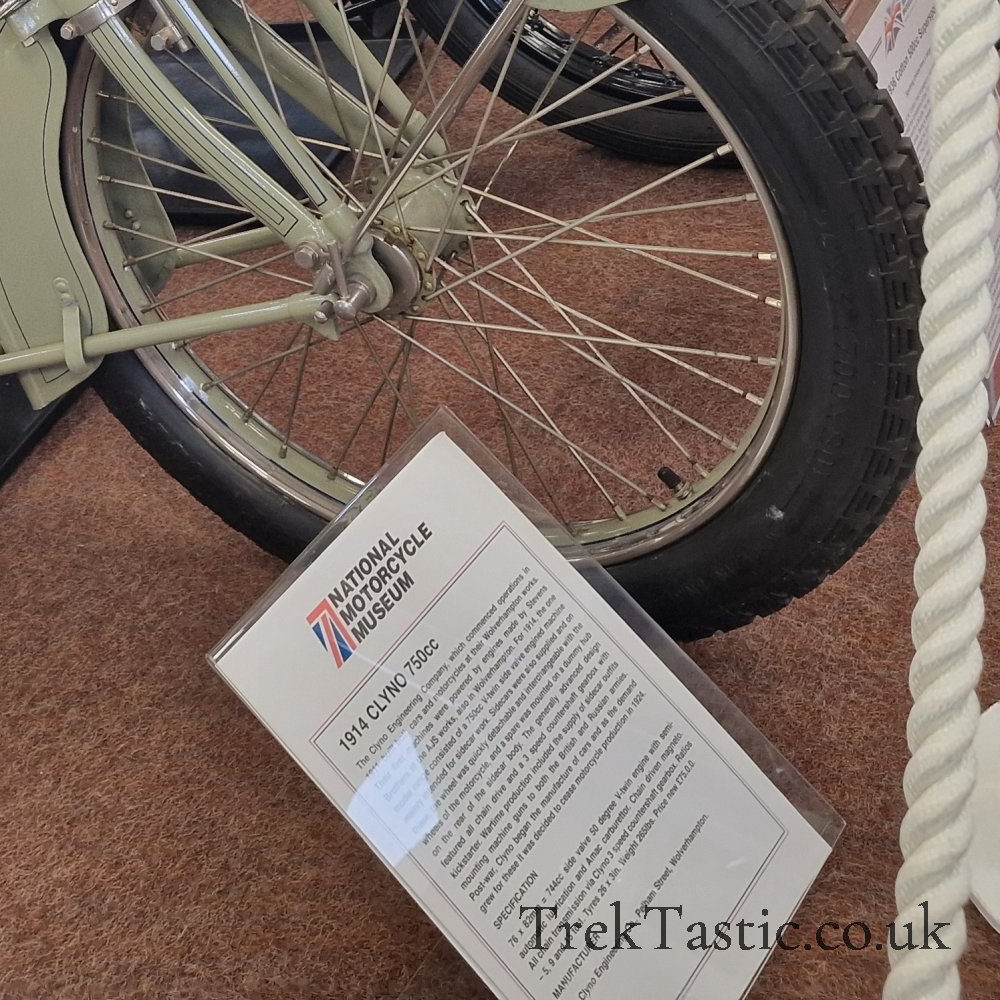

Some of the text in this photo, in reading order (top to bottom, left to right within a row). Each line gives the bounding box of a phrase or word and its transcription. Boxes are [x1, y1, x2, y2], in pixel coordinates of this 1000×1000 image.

[327, 531, 399, 608] NATIONAL
[339, 521, 432, 625] MOTORCYCLE
[350, 570, 414, 643] MUSEUM
[409, 577, 538, 729] cars motorcycles their Wolverhampton works.
[433, 584, 547, 720] were powered engines made Stevens
[339, 716, 369, 751] 1914
[366, 672, 407, 720] CLYNO
[403, 638, 439, 675] 750cc
[355, 754, 370, 769] The
[368, 733, 388, 754] Clyno
[386, 693, 423, 733] Engineering
[420, 662, 449, 693] Company,
[448, 641, 466, 661] which
[465, 603, 497, 642] commenced
[496, 573, 524, 605] operations
[422, 819, 443, 845] wheels
[458, 761, 491, 800] motorcycle,
[504, 721, 520, 742] spare
[529, 679, 553, 709] mounted
[562, 643, 582, 668] dummy
[579, 632, 591, 645] hub
[425, 594, 556, 752] AJS works, also Wolverhampton. For 1914, one
[428, 603, 565, 770] consisted 750cc V-twin side valve engined machine
[439, 632, 575, 800] wheel quickly detachable interchangeable with
[453, 641, 600, 829] rear sidecar body. The generally advanced design
[455, 632, 557, 759] sidecar work. Sidecars were also supplied
[440, 651, 609, 867] featured all chain drive speed countershaft gearbox with
[449, 661, 618, 879] kickstarter. Wartime production included supply sidecar outfits
[460, 672, 628, 890] mounting machine guns both British Russian armies.
[468, 678, 637, 901] Post-war, Clyno began manufacture cars demand
[479, 690, 644, 914] grew these decided cease motorcycle production 1924.
[507, 721, 673, 947] 76 744cc side valve 50 degree V-twin engine with semi-
[581, 759, 695, 916] Tyres 26 3in. Weight 265lbs. Price new £75.0.0.
[585, 732, 682, 866] Amac carburettor. Chain driven magneto.
[493, 869, 538, 929] SPECIFICATION
[528, 740, 692, 970] All via Clyno speed countershaft gearbox. Ratios
[577, 814, 709, 999] Clyno Pelham Street, Wolverhampton.
